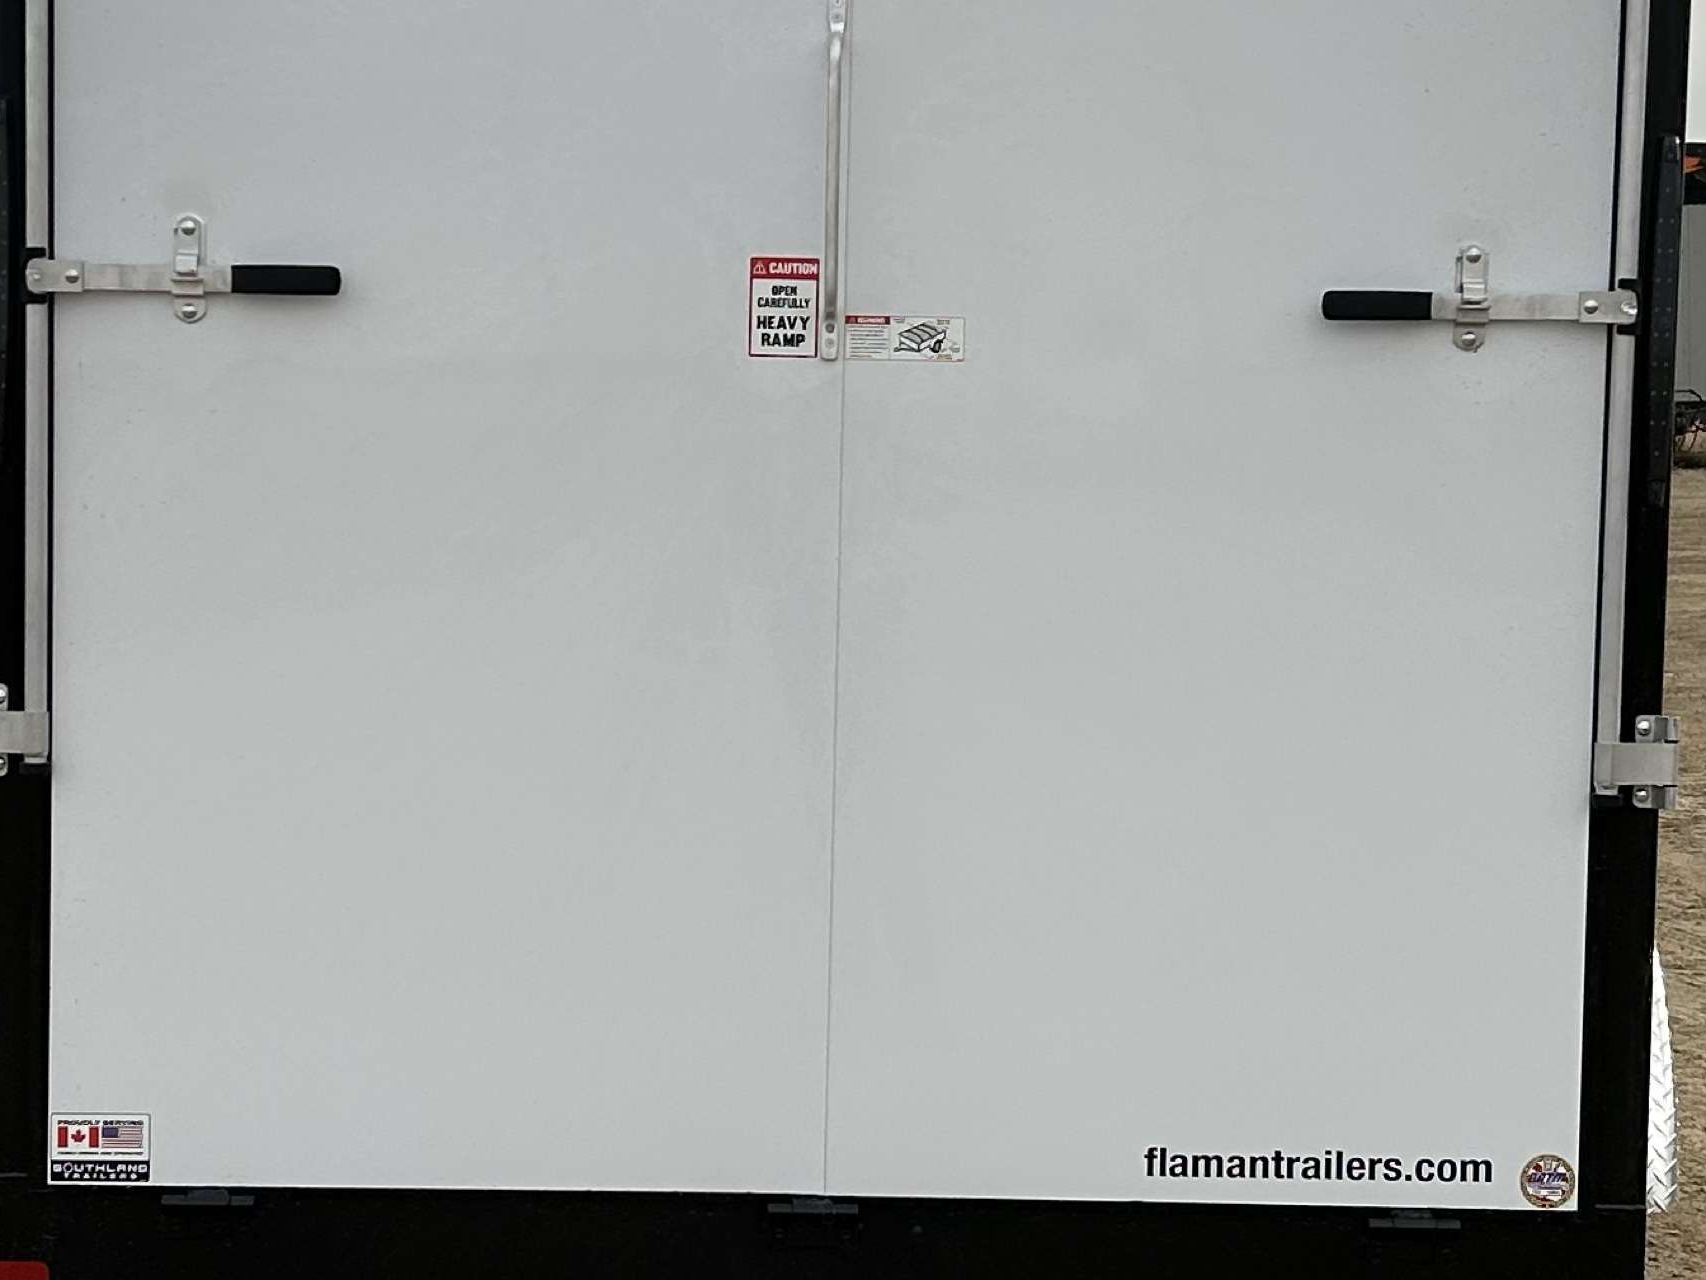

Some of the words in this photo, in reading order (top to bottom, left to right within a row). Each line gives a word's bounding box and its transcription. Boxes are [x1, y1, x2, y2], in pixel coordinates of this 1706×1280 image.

[769, 262, 818, 275] CAUTION
[771, 285, 798, 297] OPEN
[757, 297, 811, 309] CAREFULLY
[756, 315, 811, 331] HEAVY
[761, 332, 806, 347] RAMP
[53, 1162, 148, 1173] SOUTHLAND
[1143, 1146, 1493, 1183] flamantrailers.com
